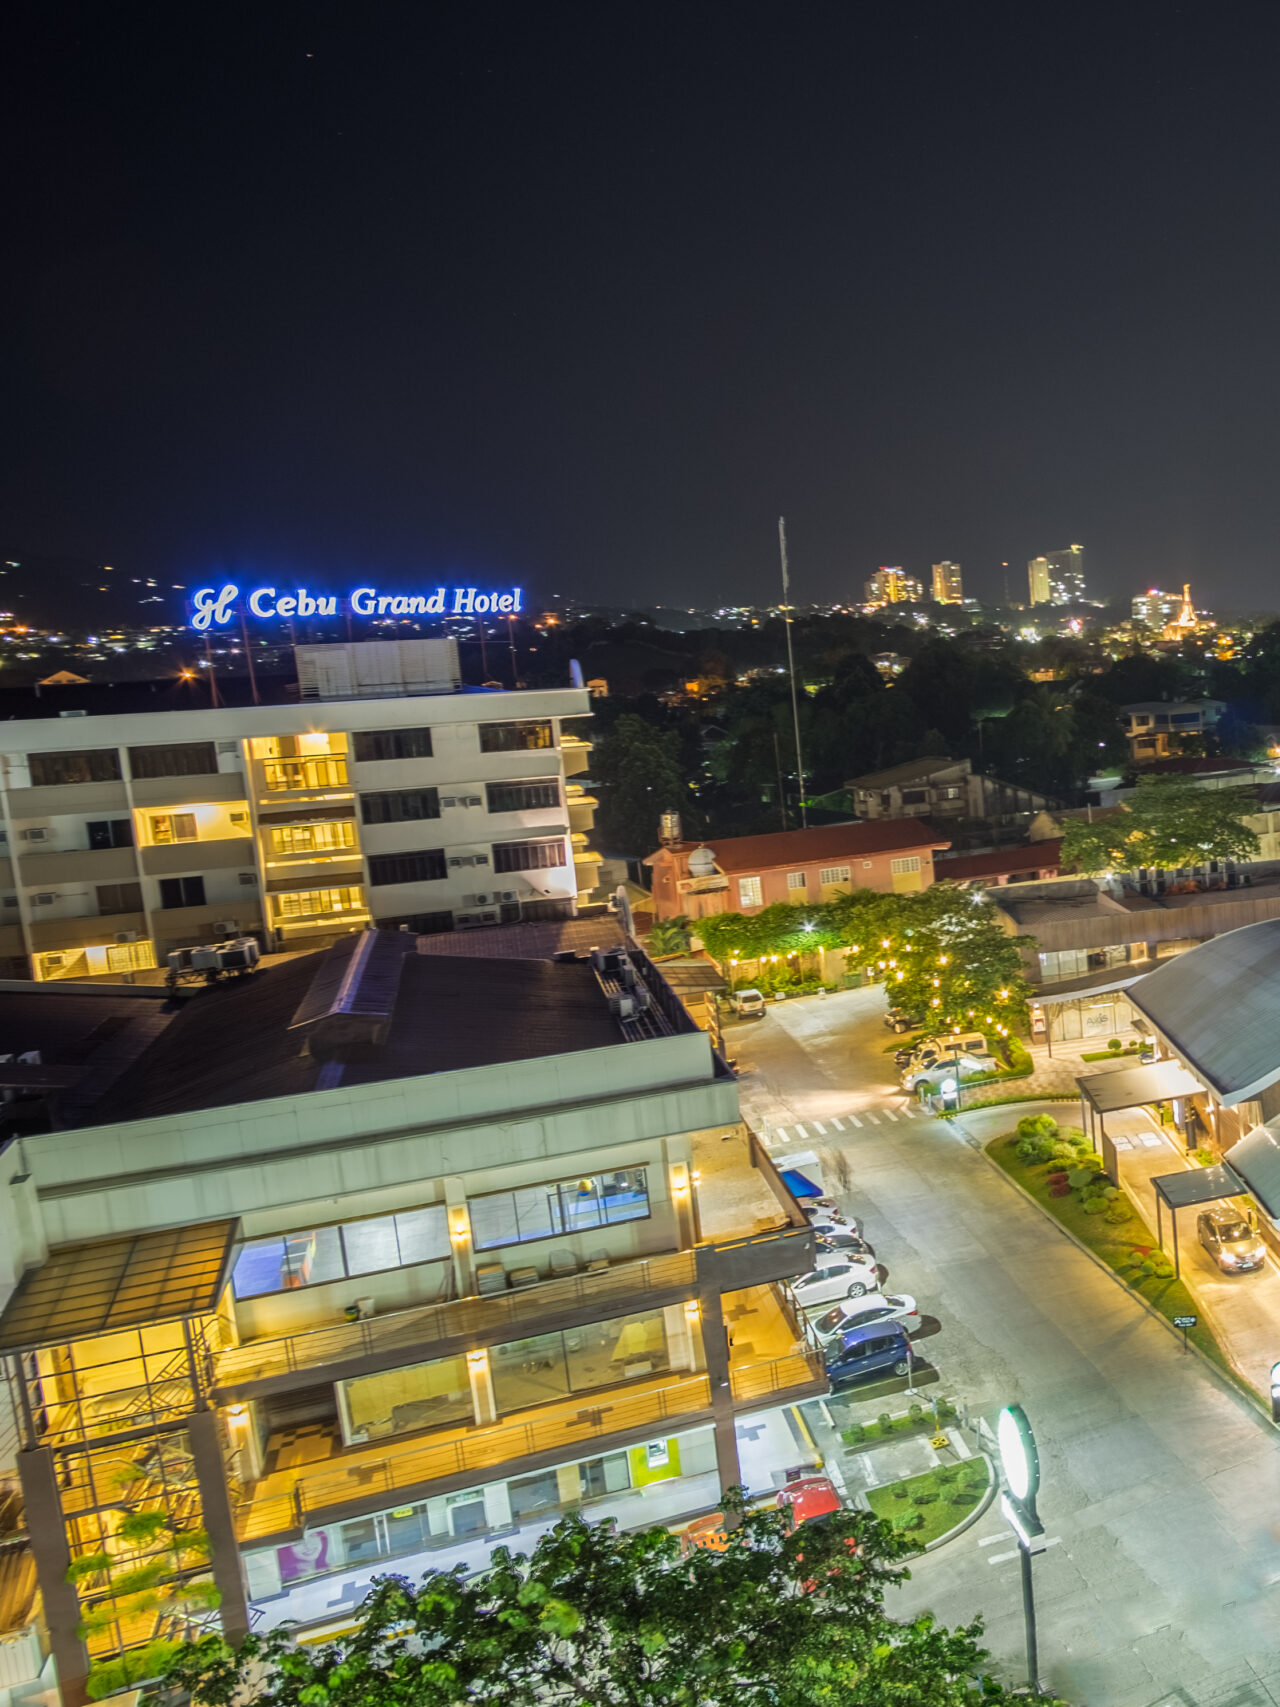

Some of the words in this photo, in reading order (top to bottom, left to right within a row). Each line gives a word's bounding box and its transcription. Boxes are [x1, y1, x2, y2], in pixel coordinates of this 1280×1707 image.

[249, 588, 337, 617] Cebu
[351, 588, 446, 615] Grand
[452, 588, 523, 613] Hotel
